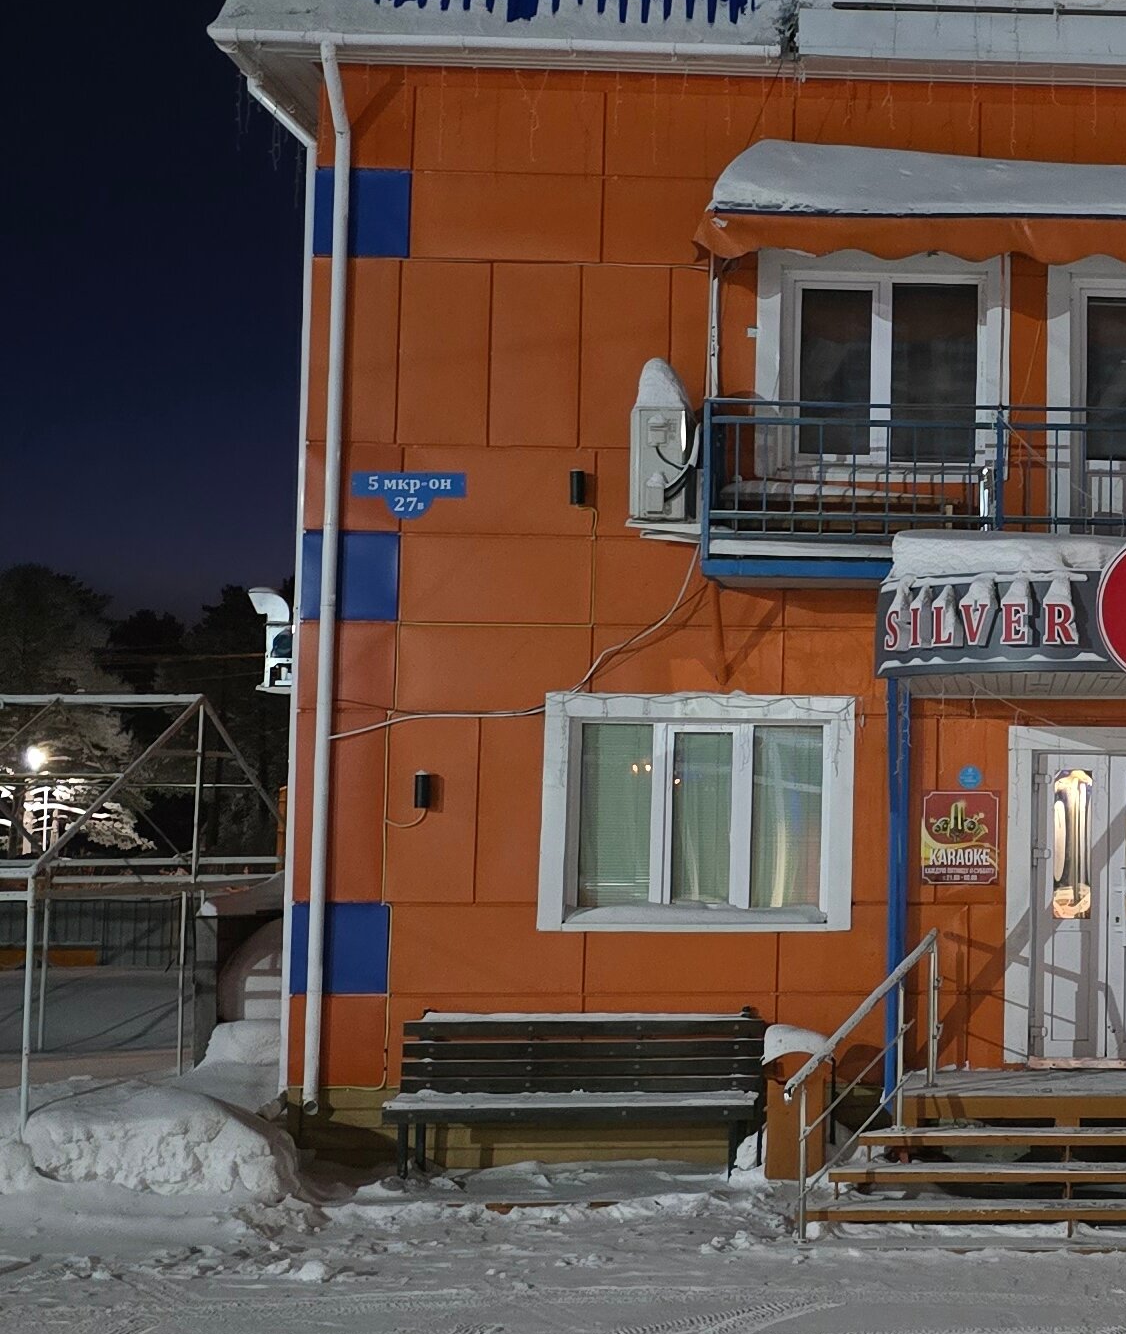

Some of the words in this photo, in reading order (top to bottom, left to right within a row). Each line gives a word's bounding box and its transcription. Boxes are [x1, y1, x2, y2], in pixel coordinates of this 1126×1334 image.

[367, 475, 379, 491] 5
[384, 477, 452, 494] мкр-он
[884, 600, 1080, 652] SILVER
[929, 848, 991, 866] KARAOKE
